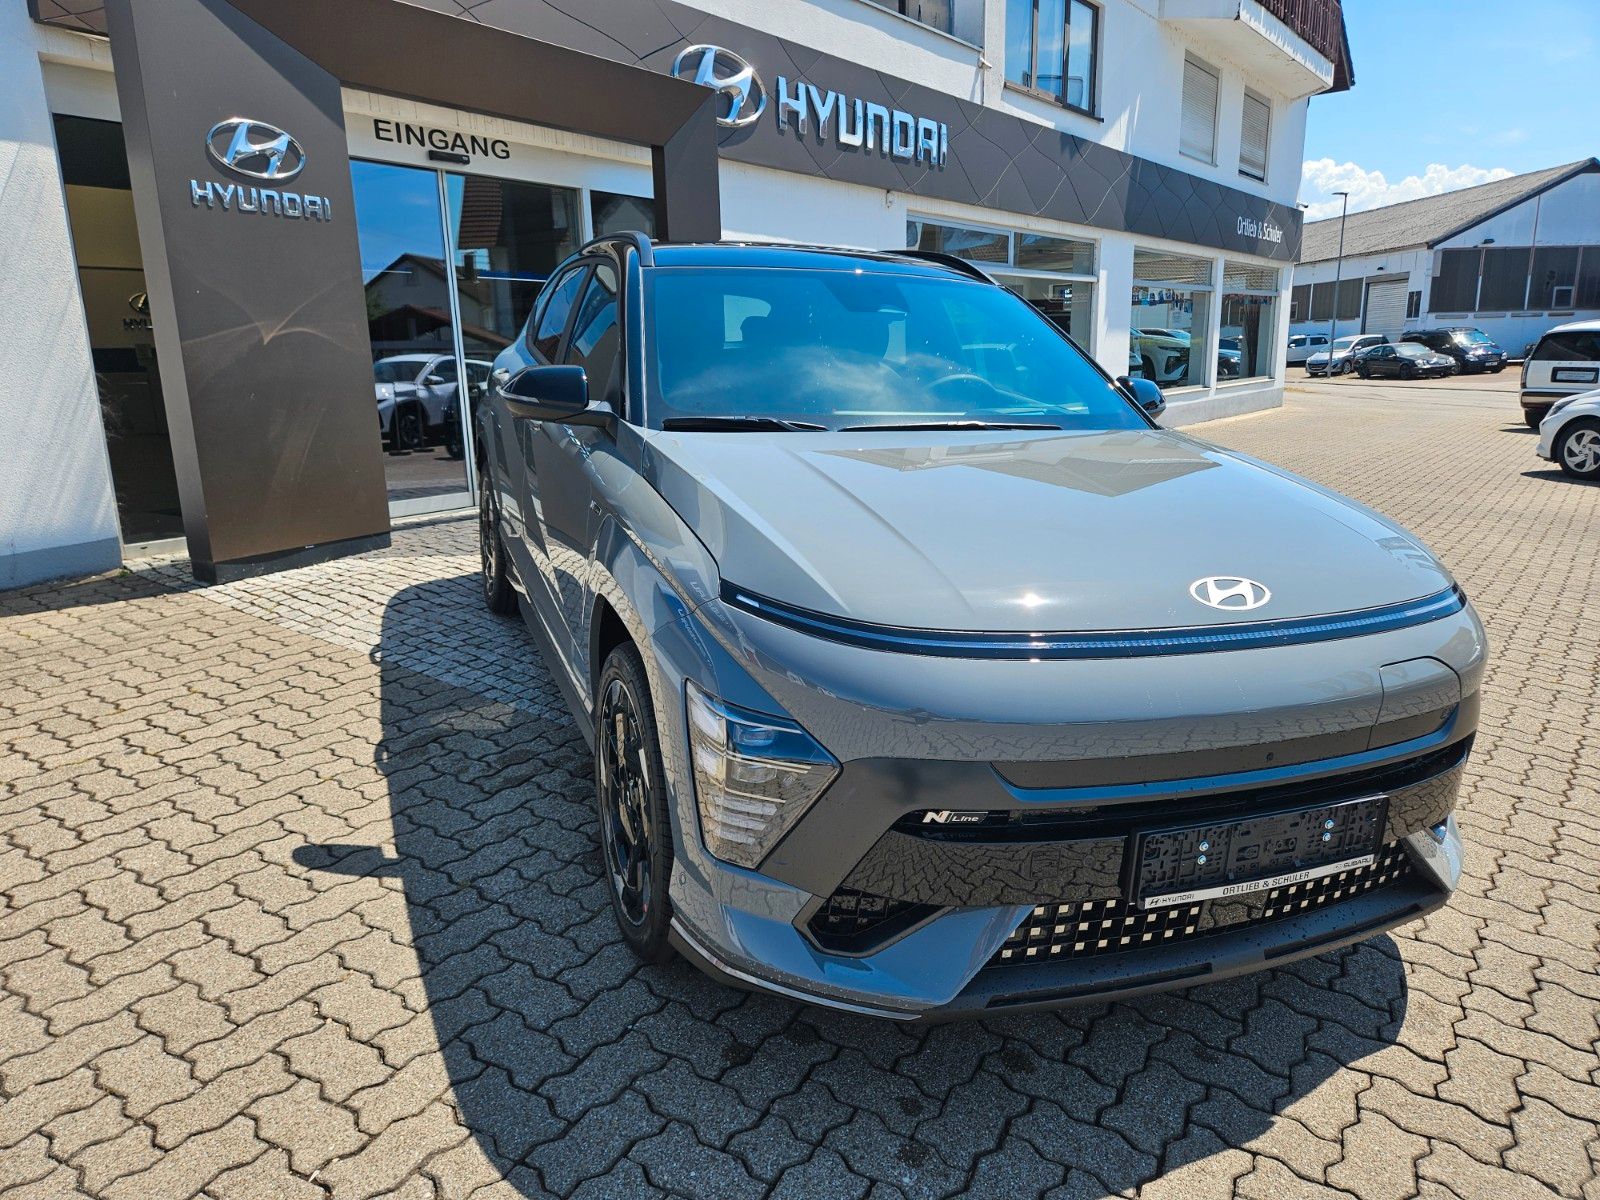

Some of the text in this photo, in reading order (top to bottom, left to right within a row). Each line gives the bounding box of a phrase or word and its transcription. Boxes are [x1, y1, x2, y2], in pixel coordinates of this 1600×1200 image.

[776, 75, 948, 168] HYUNDAI
[373, 118, 511, 160] EINGANG
[190, 179, 332, 221] HYUNDAI
[1237, 216, 1257, 238] Ortlieb
[1257, 221, 1263, 239] &
[922, 810, 951, 823] N
[1343, 857, 1372, 869] SUBARU
[1222, 871, 1310, 896] ORTLIEB & SCHULER
[1161, 893, 1195, 903] HYUNDAI
